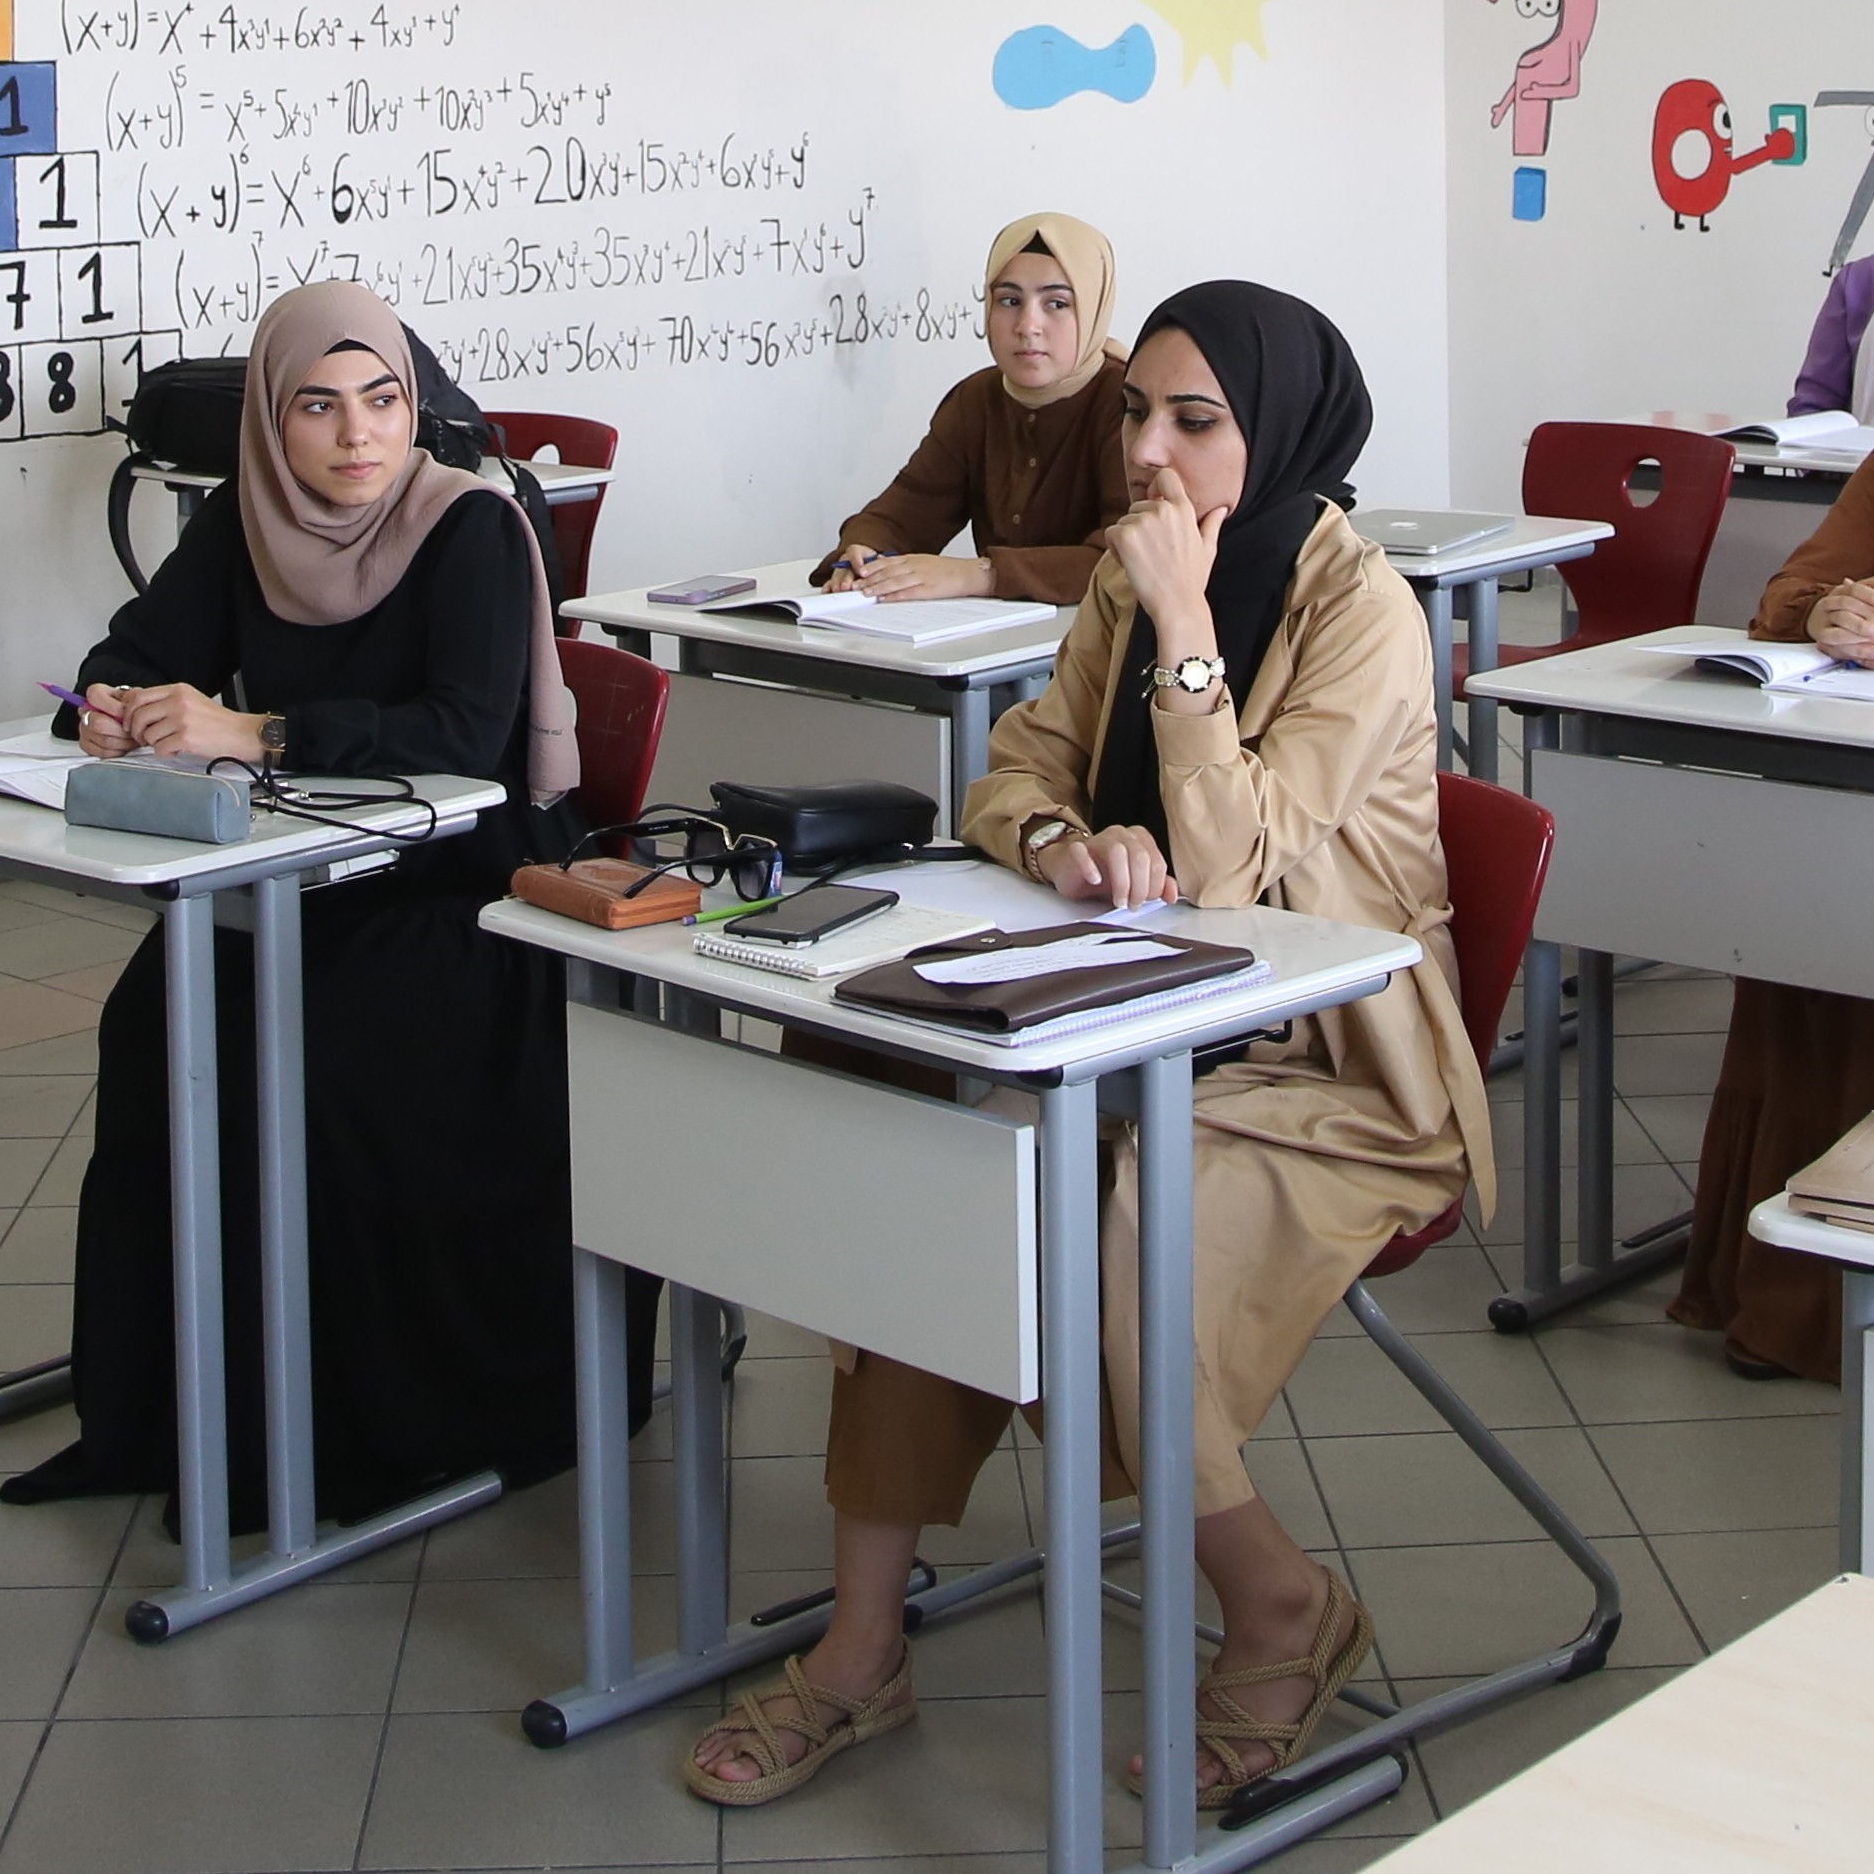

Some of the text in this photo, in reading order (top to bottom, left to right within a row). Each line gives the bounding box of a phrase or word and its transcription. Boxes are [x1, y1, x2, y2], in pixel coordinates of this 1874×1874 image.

[38, 160, 77, 229] 1
[2, 264, 30, 328] 7
[80, 252, 116, 323] 1
[47, 353, 76, 412] 8
